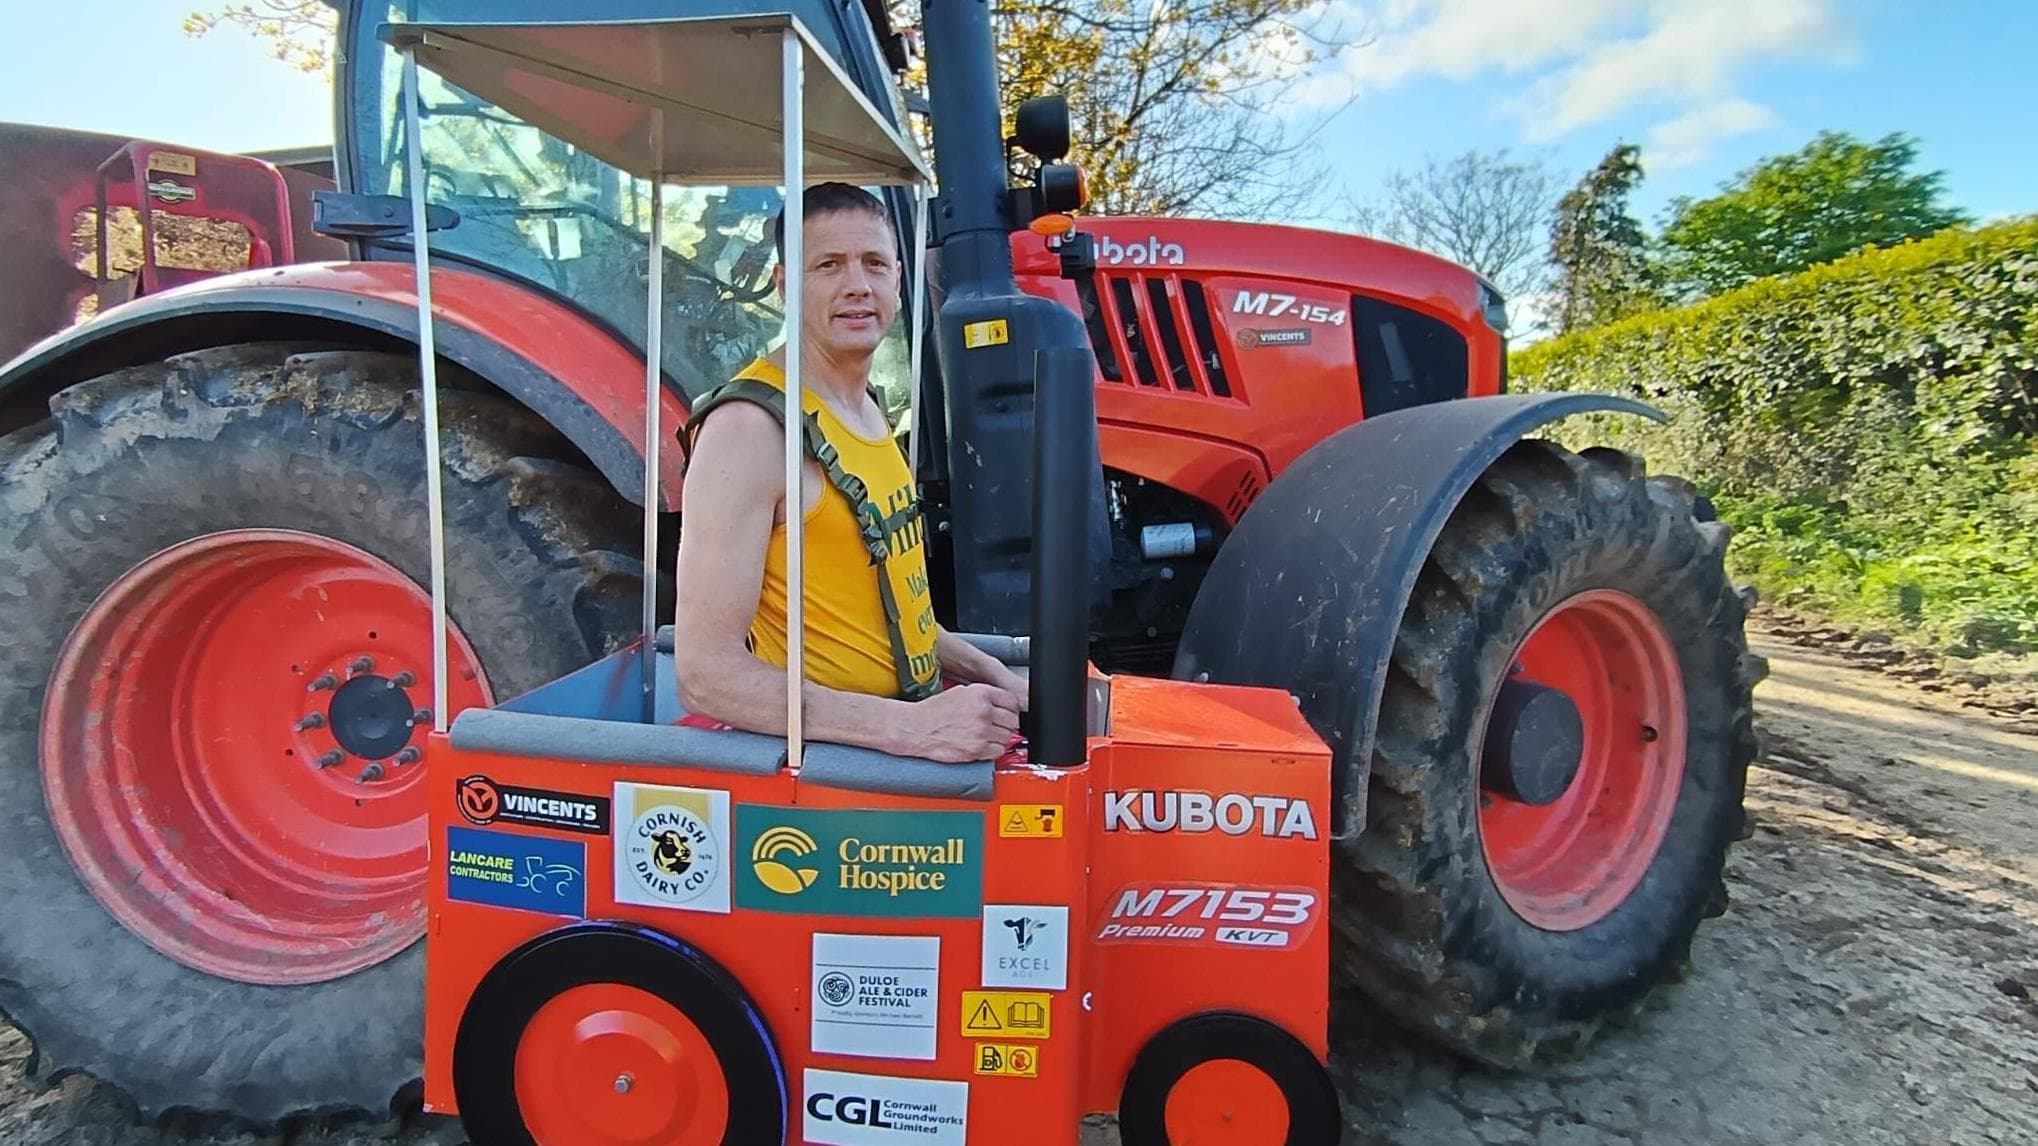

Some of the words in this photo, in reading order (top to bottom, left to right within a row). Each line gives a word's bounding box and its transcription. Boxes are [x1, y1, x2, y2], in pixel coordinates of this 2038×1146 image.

[1232, 290, 1346, 326] M7-154
[1260, 332, 1305, 342] VINCENTS
[503, 793, 598, 821] VINCENTS
[1104, 791, 1319, 840] KUBOTA
[638, 812, 707, 843] CORNISH
[450, 850, 515, 870] LANCARE
[839, 838, 965, 865] Cornwall
[449, 865, 514, 884] CONTRACTORS
[635, 861, 680, 895] DAIRY
[684, 869, 710, 892] CO.
[839, 864, 946, 897] Hospice
[1111, 889, 1316, 925] M7153
[1098, 924, 1205, 939] Premium
[1224, 930, 1281, 943] KVT
[999, 957, 1051, 971] EXCEL
[859, 975, 900, 986] DULOE
[859, 986, 880, 996] ALE
[883, 987, 892, 996] &
[894, 988, 928, 998] CIDER
[858, 997, 911, 1008] FESTIVAL
[806, 1092, 892, 1129] CGL
[883, 1099, 937, 1113] Cornwall
[883, 1109, 964, 1126] Groundworks
[893, 1121, 938, 1134] Limited
